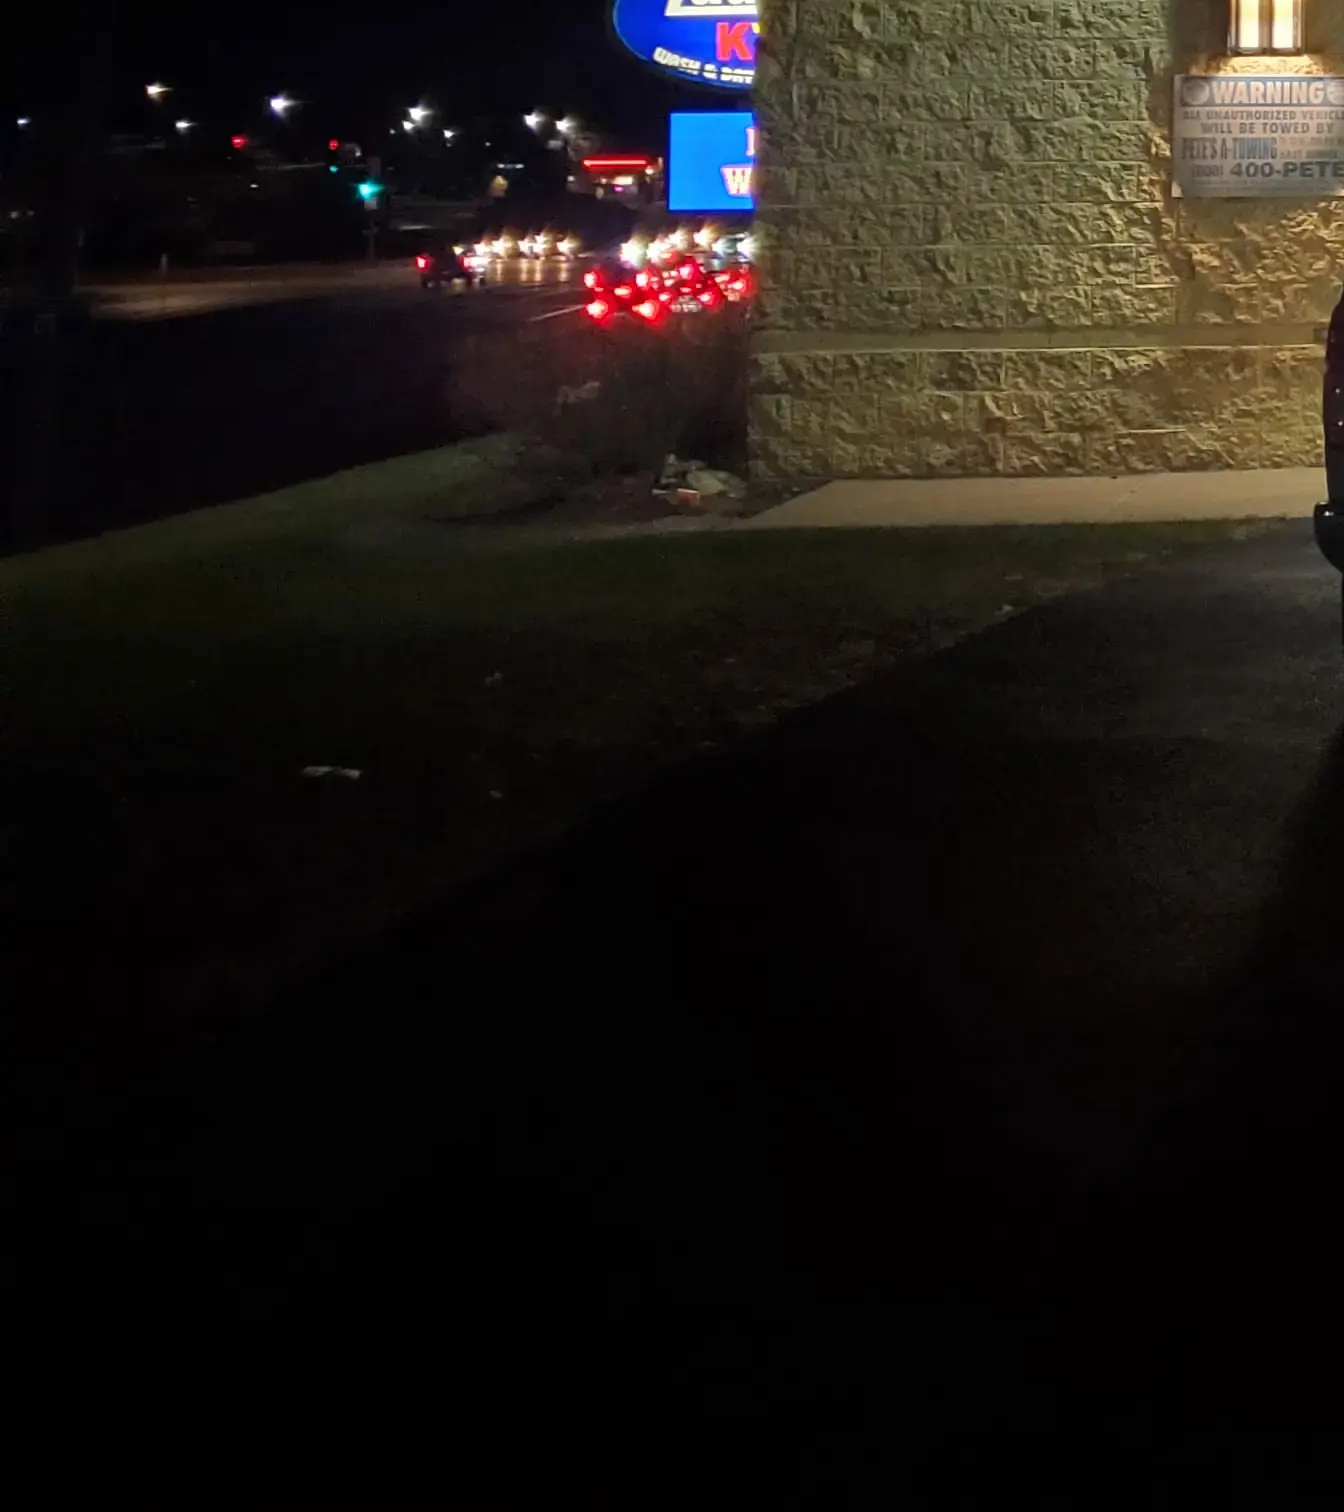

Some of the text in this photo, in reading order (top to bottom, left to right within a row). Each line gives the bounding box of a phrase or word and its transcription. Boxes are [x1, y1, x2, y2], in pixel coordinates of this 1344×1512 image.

[1211, 80, 1325, 105] WARNING
[1206, 110, 1297, 121] UNAUTHORIZED
[1200, 121, 1336, 135] WILL BE TOWED BY
